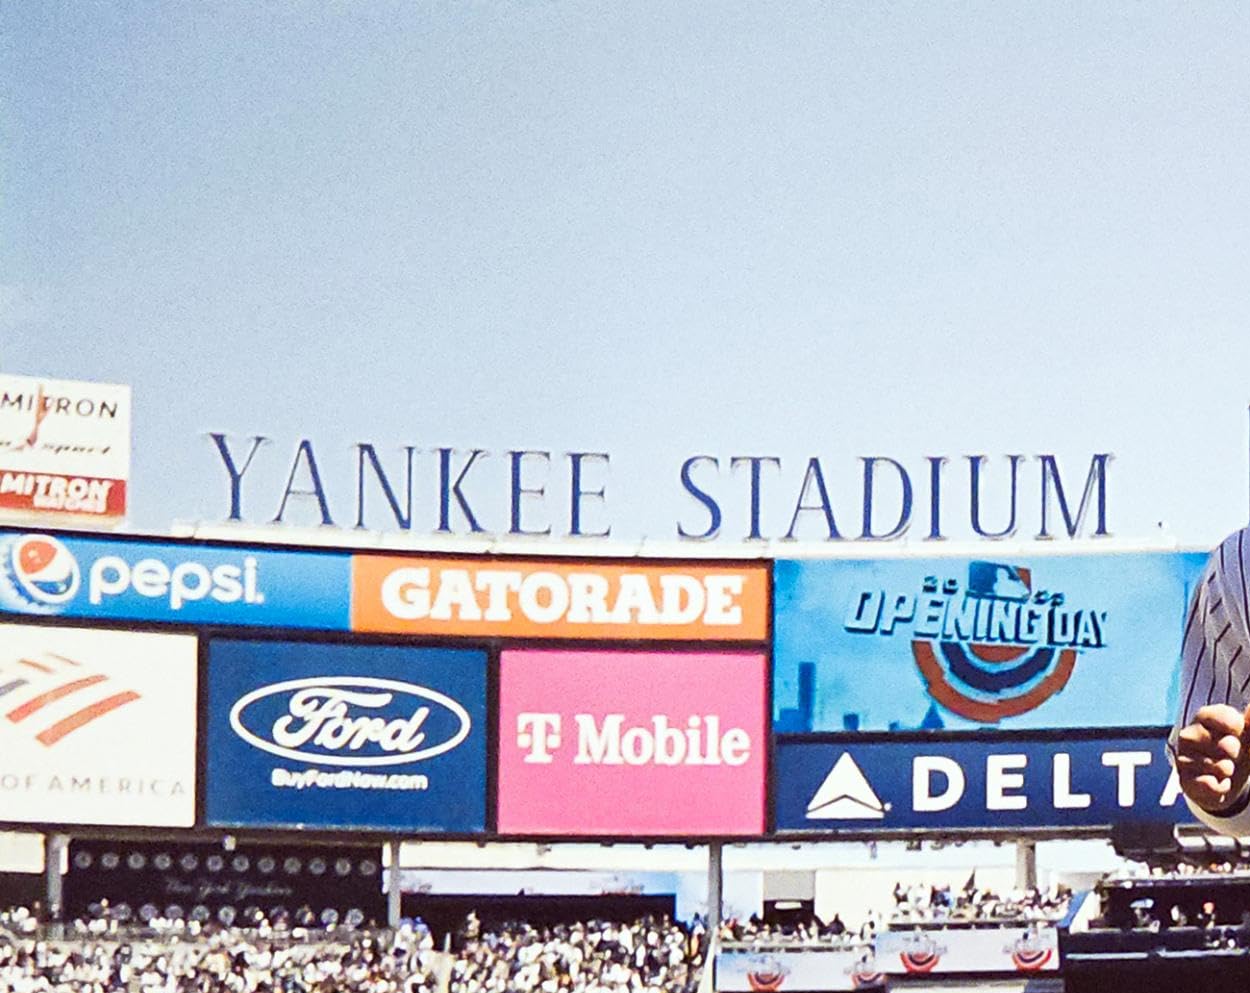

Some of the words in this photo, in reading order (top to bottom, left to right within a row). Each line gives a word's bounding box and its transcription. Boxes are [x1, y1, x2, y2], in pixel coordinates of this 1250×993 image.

[205, 432, 611, 537] YANKEE
[676, 453, 1116, 542] STADIUM
[88, 556, 260, 610] pepsi
[380, 567, 743, 626] GATORADE
[844, 589, 1042, 645] OPENING
[271, 687, 430, 752] Ford
[573, 713, 751, 766] Mobile
[1, 773, 37, 790] OF
[48, 774, 186, 797] AMERICA
